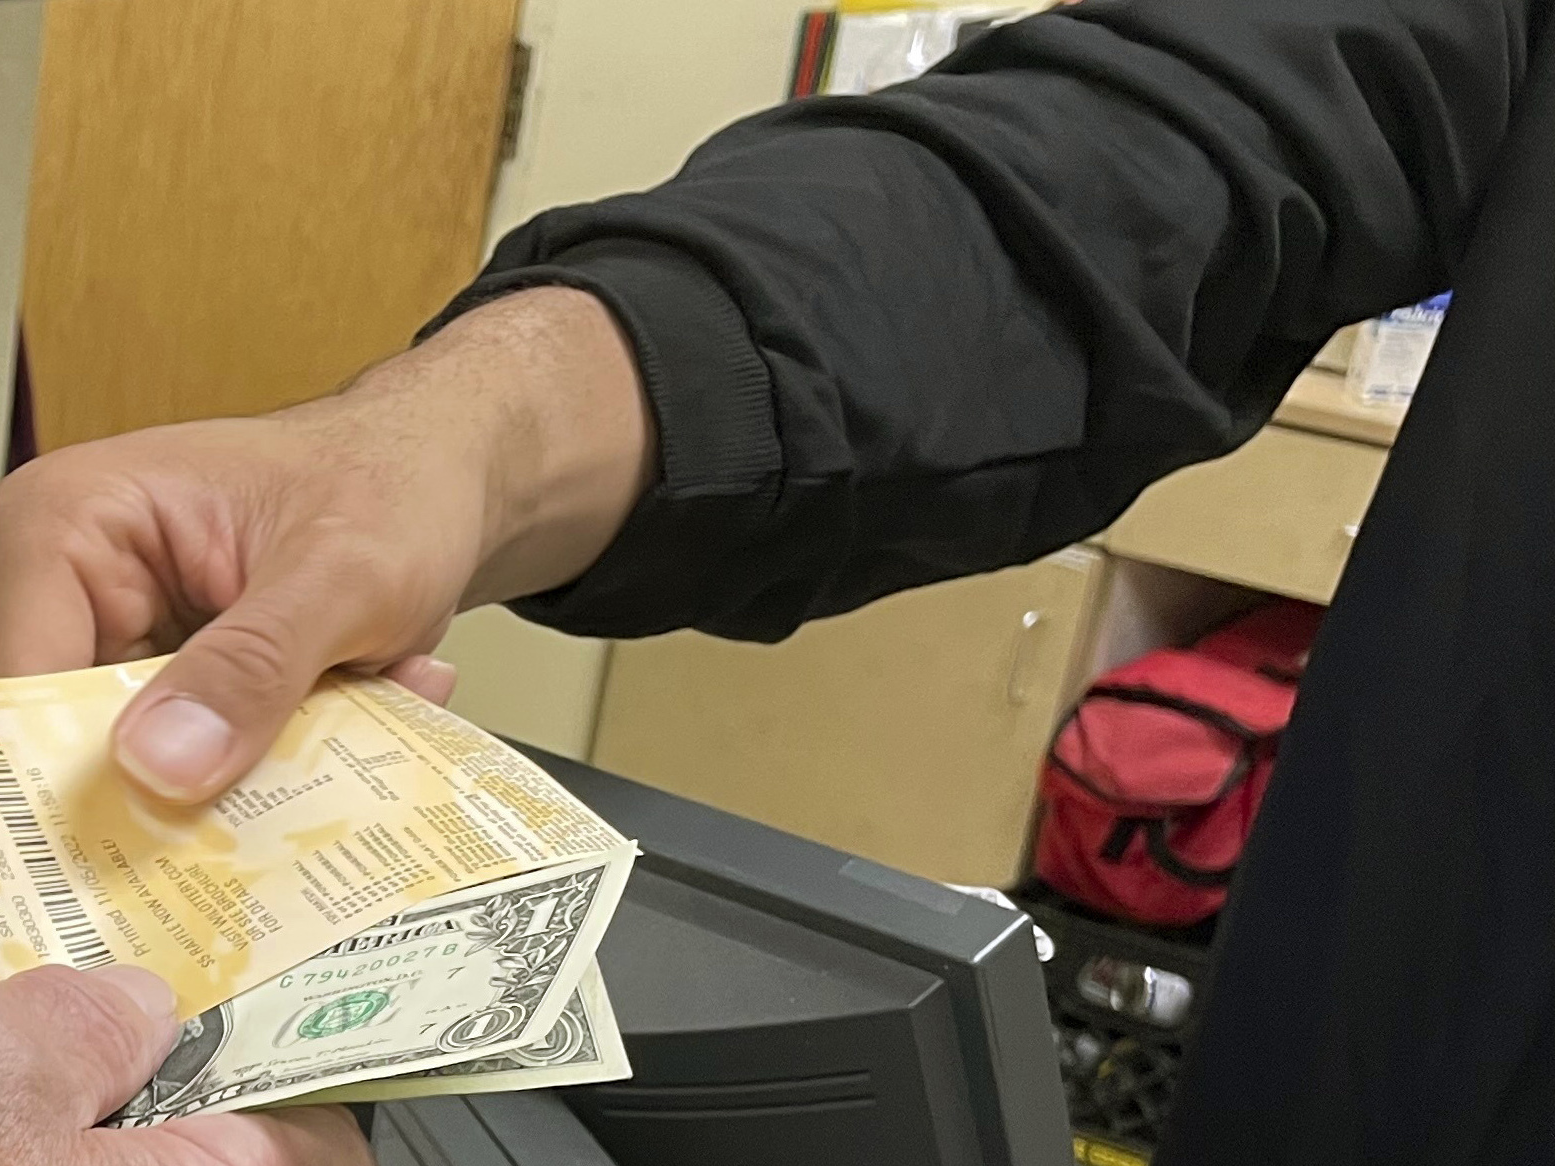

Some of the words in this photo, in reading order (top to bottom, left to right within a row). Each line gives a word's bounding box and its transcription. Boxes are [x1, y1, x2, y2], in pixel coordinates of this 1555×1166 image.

[183, 862, 241, 913] BROCHURE
[223, 877, 266, 921] DETAILS
[145, 897, 175, 926] NOW
[230, 910, 254, 932] SEE
[258, 911, 285, 934] FOR
[106, 908, 152, 959] Printed
[168, 921, 205, 958] RAFFLE
[218, 923, 249, 952] VISIT
[302, 945, 438, 987] 79420027
